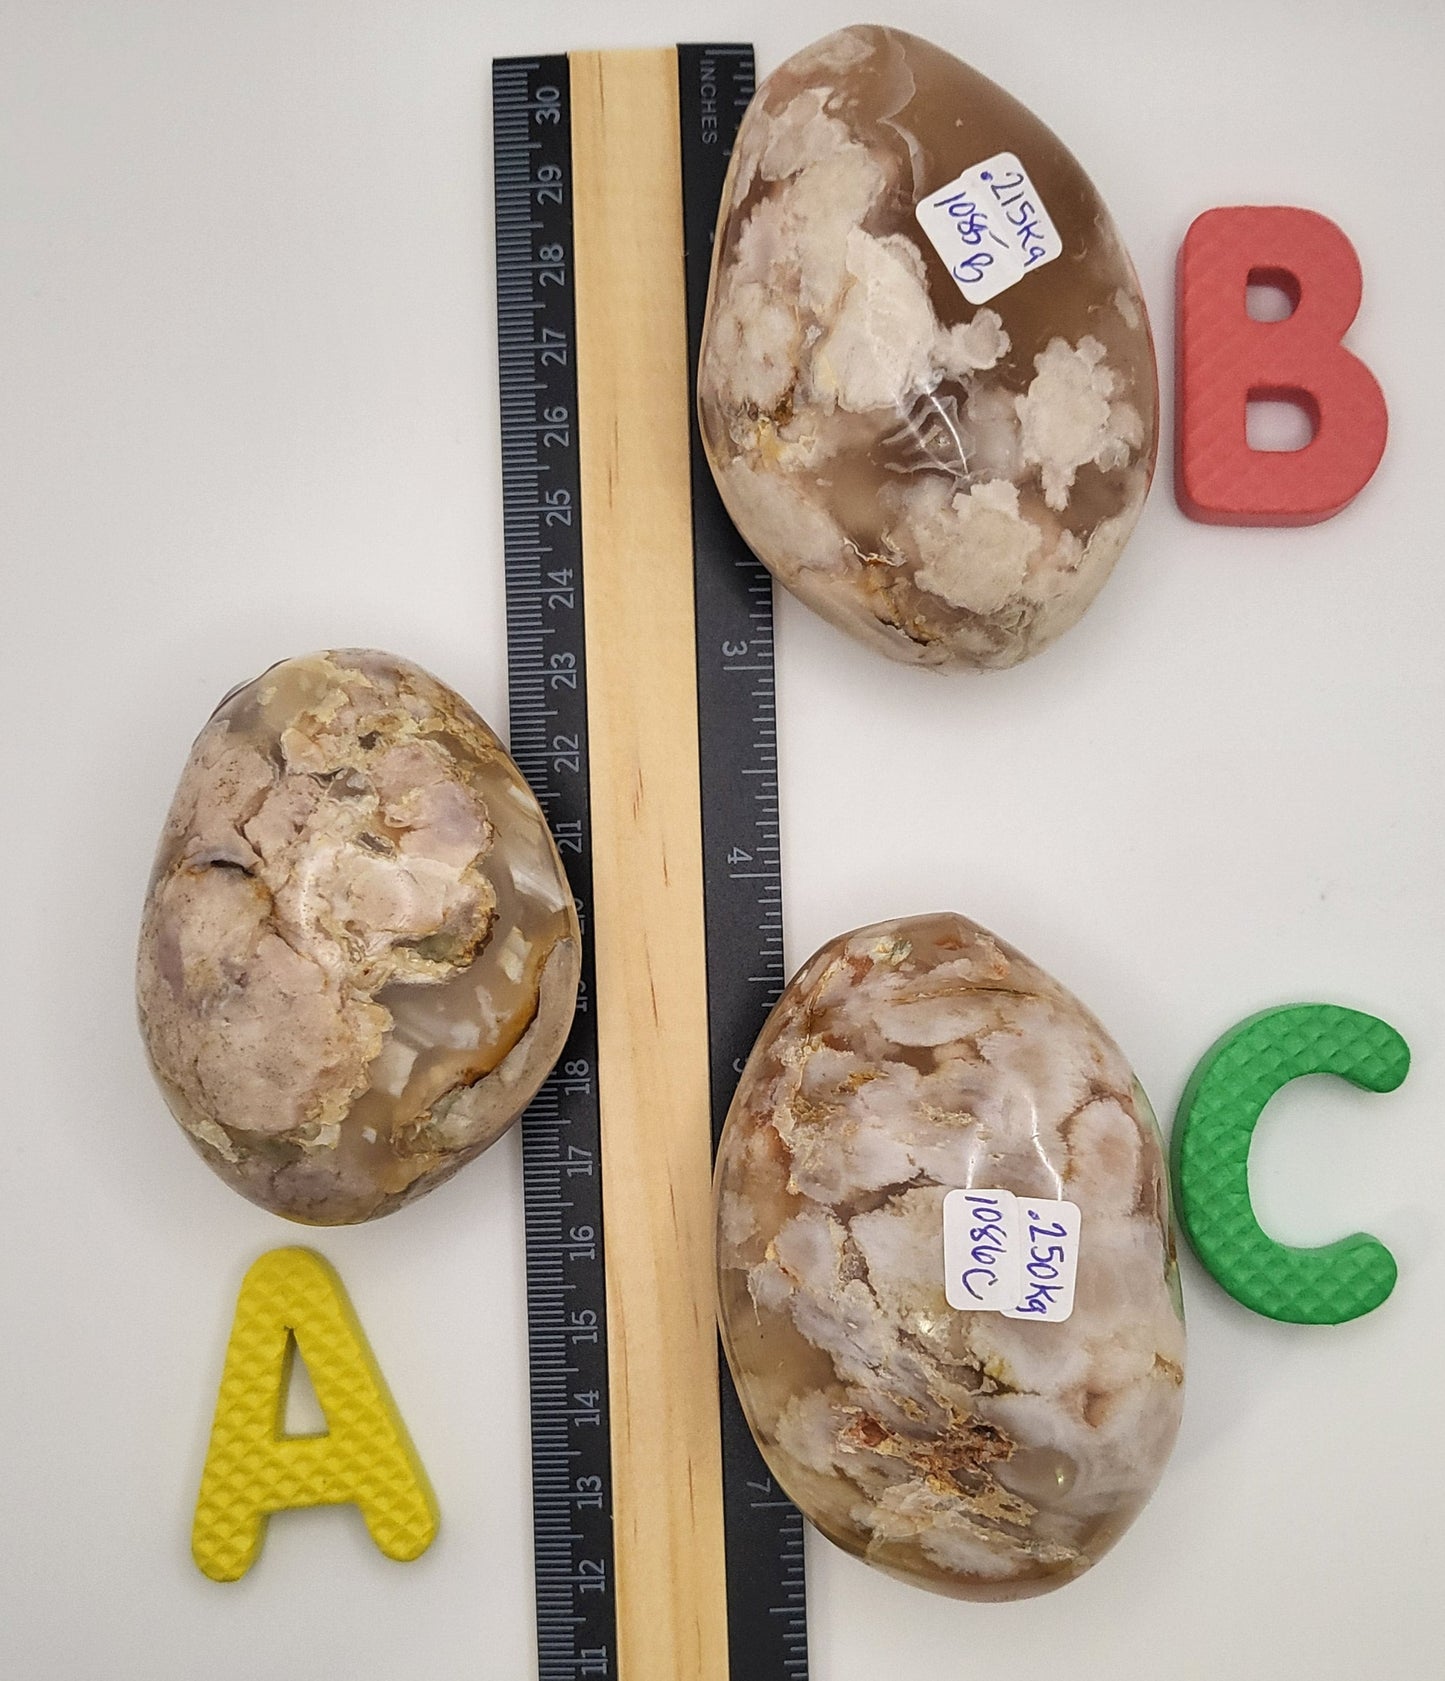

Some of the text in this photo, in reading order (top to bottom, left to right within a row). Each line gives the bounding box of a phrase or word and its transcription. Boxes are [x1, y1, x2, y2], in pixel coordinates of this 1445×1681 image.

[535, 86, 560, 125] 30
[700, 59, 717, 144] INCHES
[537, 165, 563, 205] 29
[539, 244, 565, 287] 28
[541, 328, 567, 366] 27
[1174, 206, 1388, 527] B
[544, 406, 570, 448] 26
[546, 489, 571, 527] 25
[547, 568, 574, 610] 24
[721, 640, 748, 657] 3
[551, 652, 577, 690] 23
[553, 734, 579, 773] 22
[556, 819, 582, 854] 21
[727, 846, 753, 865] 4
[564, 1059, 590, 1096] 18
[566, 1145, 593, 1178] 17
[1171, 1002, 1411, 1325] C
[569, 1225, 595, 1261] 16
[571, 1309, 597, 1345] 15
[191, 1246, 440, 1582] A
[574, 1390, 600, 1427] 14
[576, 1475, 602, 1510] 13
[746, 1477, 771, 1494] 7
[578, 1559, 605, 1594] 12
[581, 1645, 607, 1676] 11
